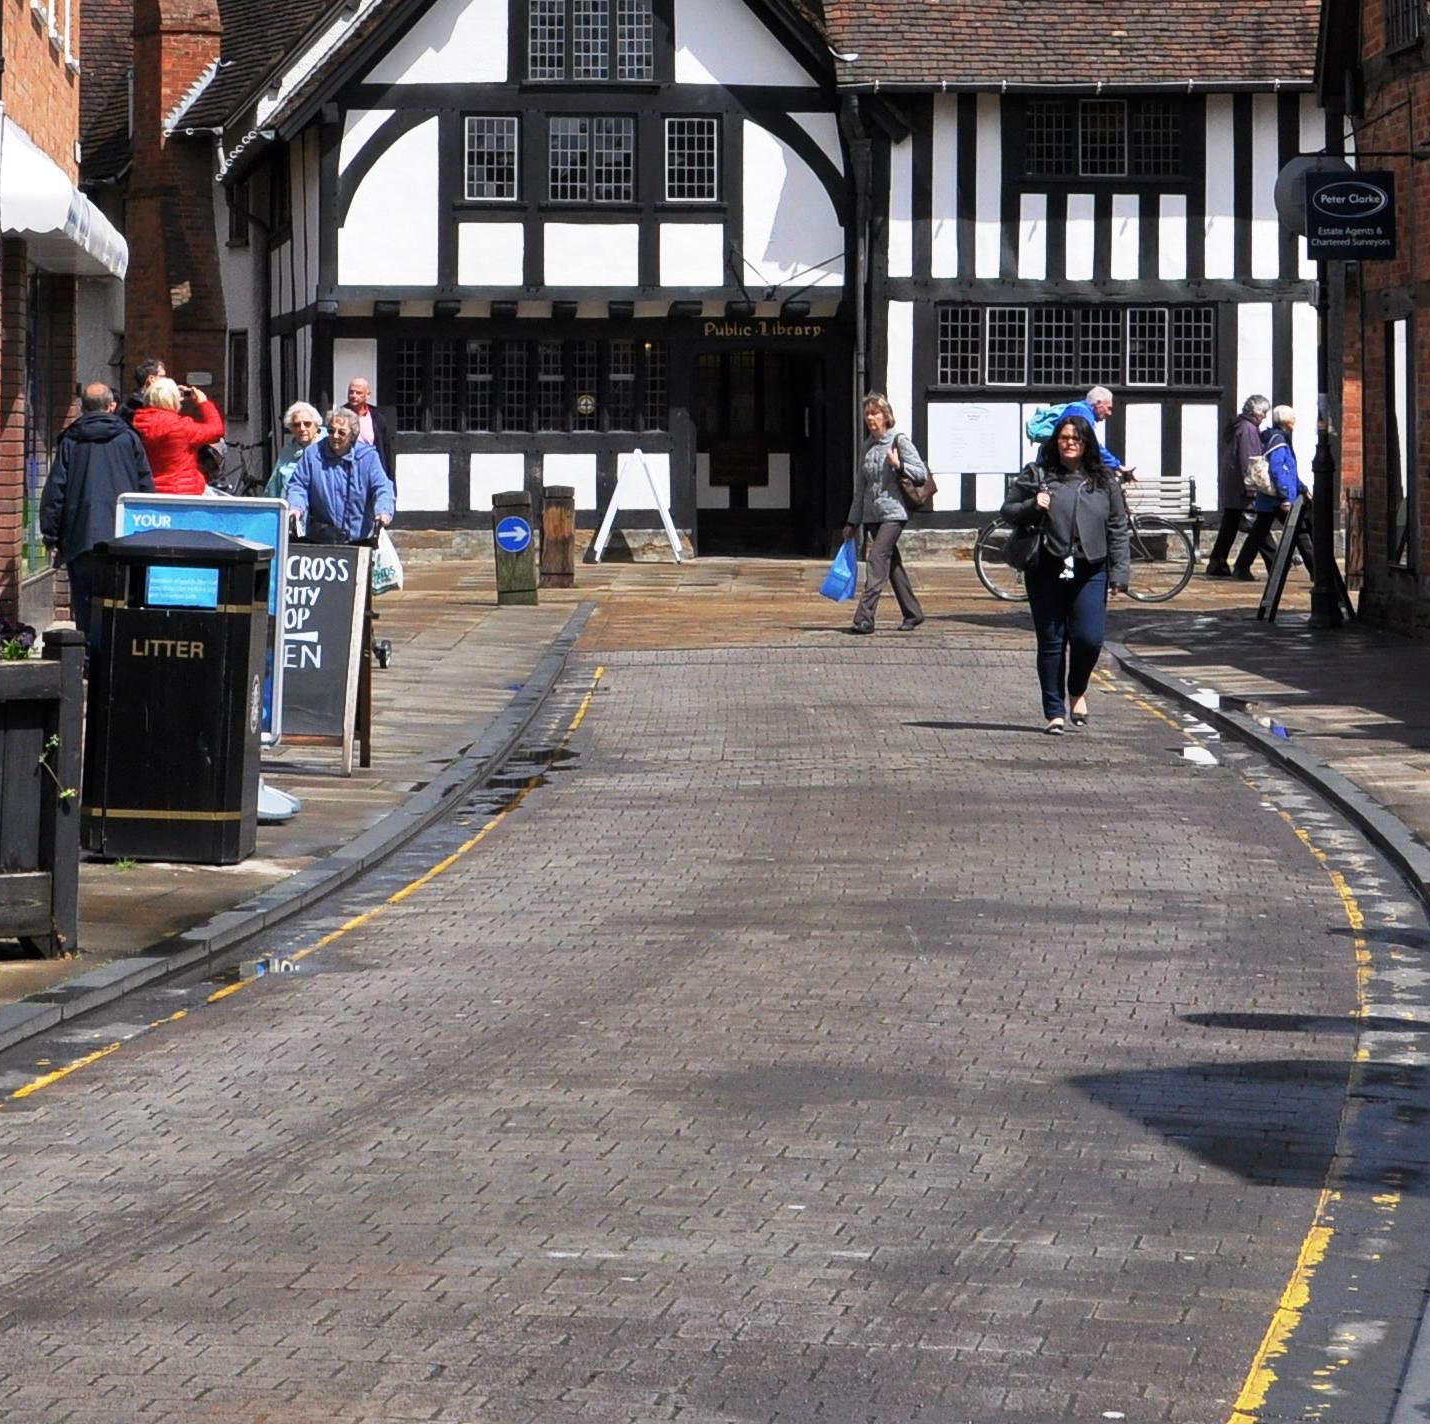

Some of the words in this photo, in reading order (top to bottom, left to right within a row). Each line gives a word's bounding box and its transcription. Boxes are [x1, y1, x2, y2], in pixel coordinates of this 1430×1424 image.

[1320, 194, 1346, 204] Peter
[1348, 193, 1381, 204] Clarke
[1317, 227, 1343, 236] Estate
[1345, 227, 1375, 237] Agents
[1311, 238, 1351, 246] Chartered
[1353, 238, 1391, 247] Surveyors
[704, 320, 753, 337] Public
[758, 320, 822, 337] Library
[132, 514, 171, 528] YOUR
[286, 555, 349, 582] CROSS
[132, 639, 204, 659] LITTER
